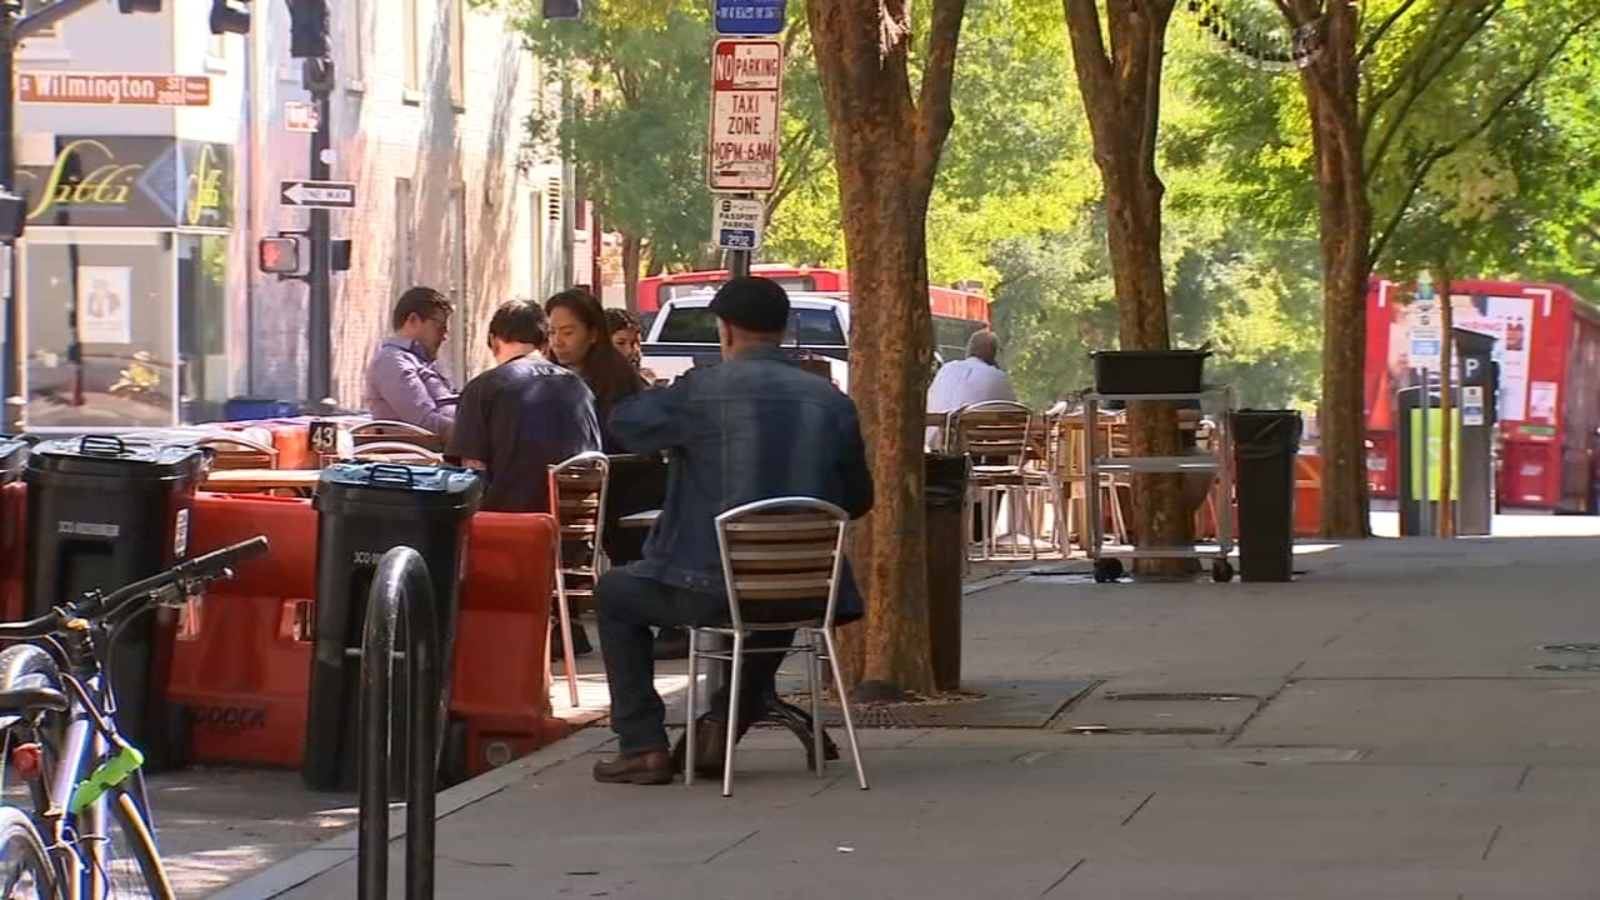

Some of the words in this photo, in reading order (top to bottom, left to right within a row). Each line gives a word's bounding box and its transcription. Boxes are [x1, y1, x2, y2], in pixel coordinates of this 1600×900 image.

[716, 54, 733, 80] NO
[735, 58, 777, 76] PARKING
[36, 75, 154, 104] Wilmington
[732, 95, 760, 113] TAXI
[728, 116, 761, 135] ZONE
[326, 190, 347, 200] WAY
[719, 212, 759, 221] PASSPORT
[722, 220, 754, 229] PARKING
[1465, 358, 1480, 377] P
[312, 426, 334, 448] 43
